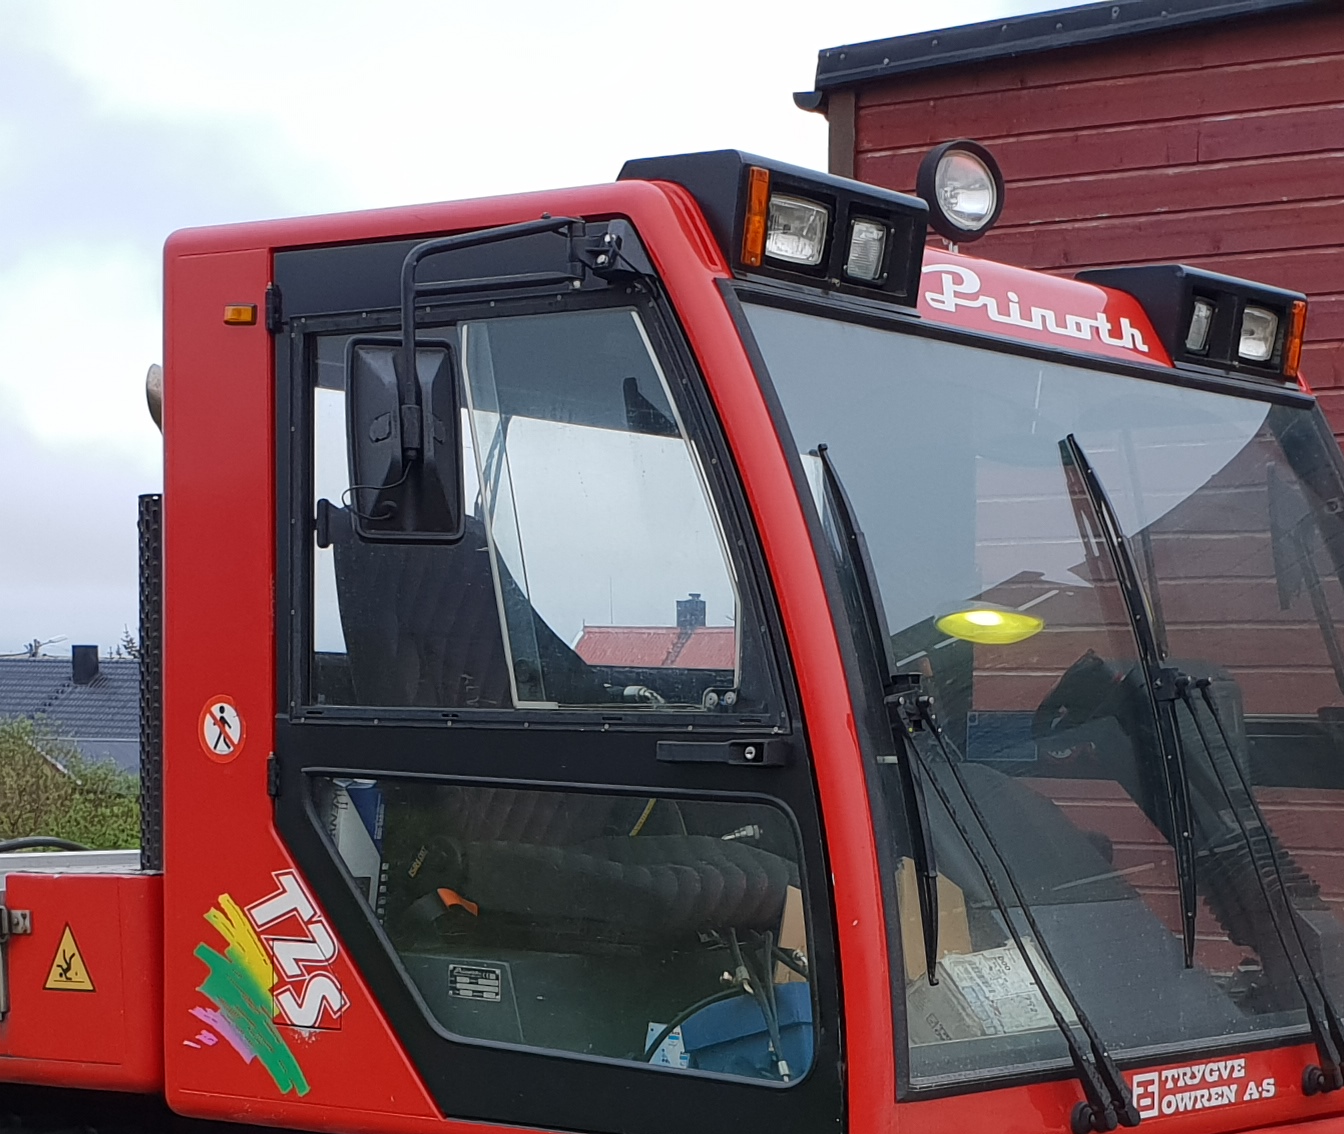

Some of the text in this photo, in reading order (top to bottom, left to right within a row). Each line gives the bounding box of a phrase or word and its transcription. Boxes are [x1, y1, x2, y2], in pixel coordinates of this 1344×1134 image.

[921, 263, 1149, 352] Prinoth
[1161, 1058, 1246, 1089] TRYGVE
[1161, 1084, 1238, 1115] OWREN
